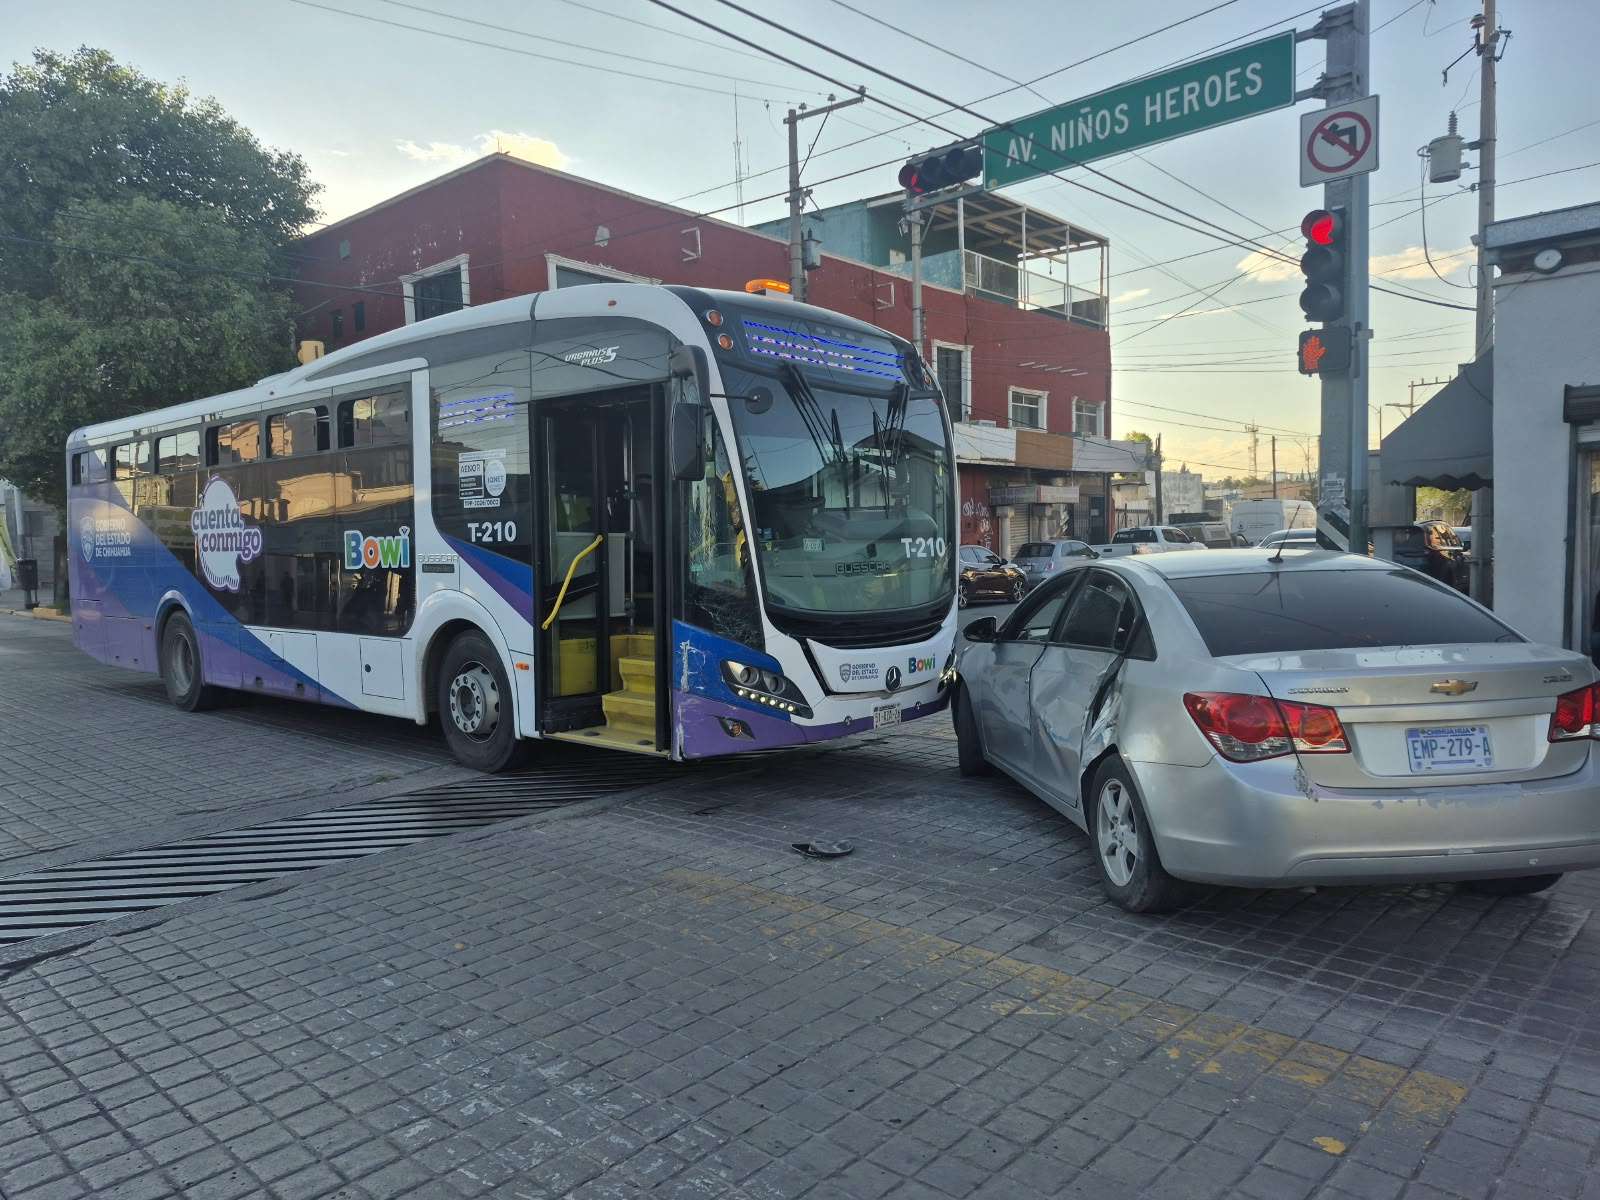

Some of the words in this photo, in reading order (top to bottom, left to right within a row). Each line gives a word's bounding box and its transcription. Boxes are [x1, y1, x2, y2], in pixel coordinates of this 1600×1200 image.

[1006, 132, 1037, 168] AV.
[1051, 103, 1130, 152] NIÑOS
[1144, 62, 1263, 126] HEROES
[95, 533, 106, 546] DEL
[107, 532, 131, 545] ESTADO
[467, 521, 517, 543] T-210
[201, 528, 261, 560] conmigo
[900, 536, 946, 559] T-210
[1411, 736, 1492, 760] EMP-279-A
